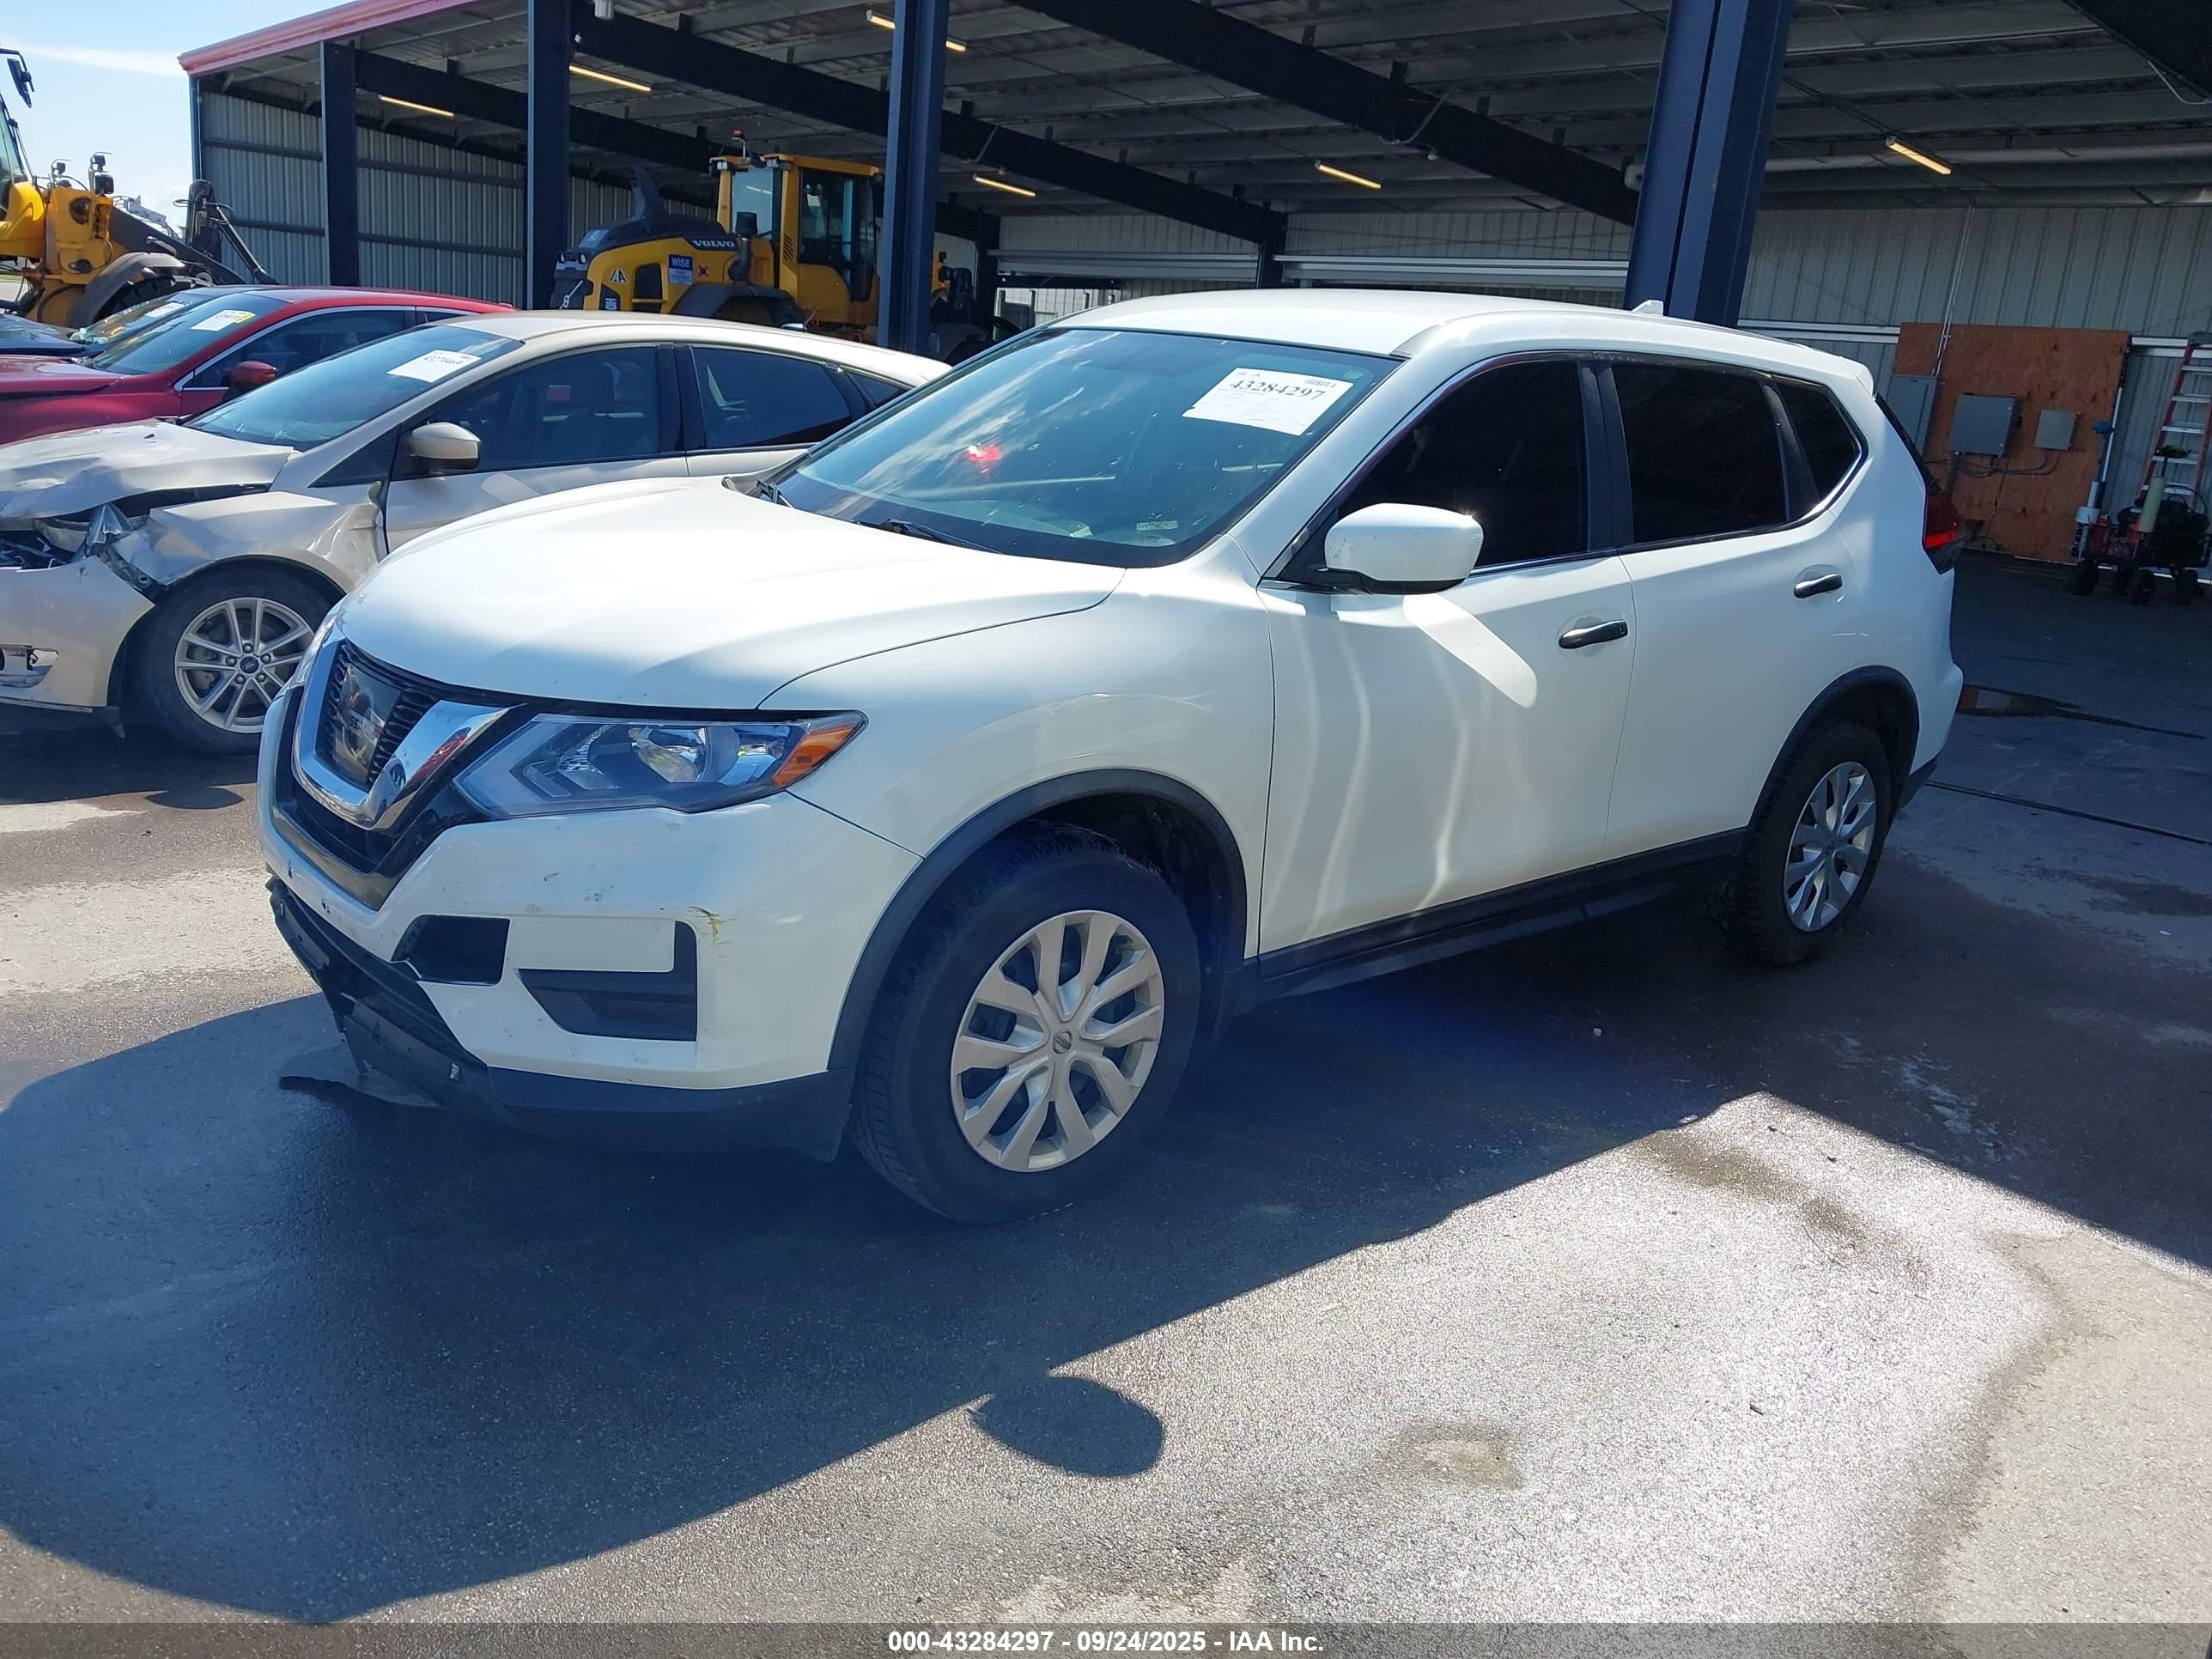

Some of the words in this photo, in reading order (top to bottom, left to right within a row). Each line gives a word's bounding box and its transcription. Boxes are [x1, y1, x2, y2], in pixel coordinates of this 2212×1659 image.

[692, 240, 735, 248] VOLVO
[672, 257, 690, 268] WISE
[1230, 380, 1327, 400] 43284297
